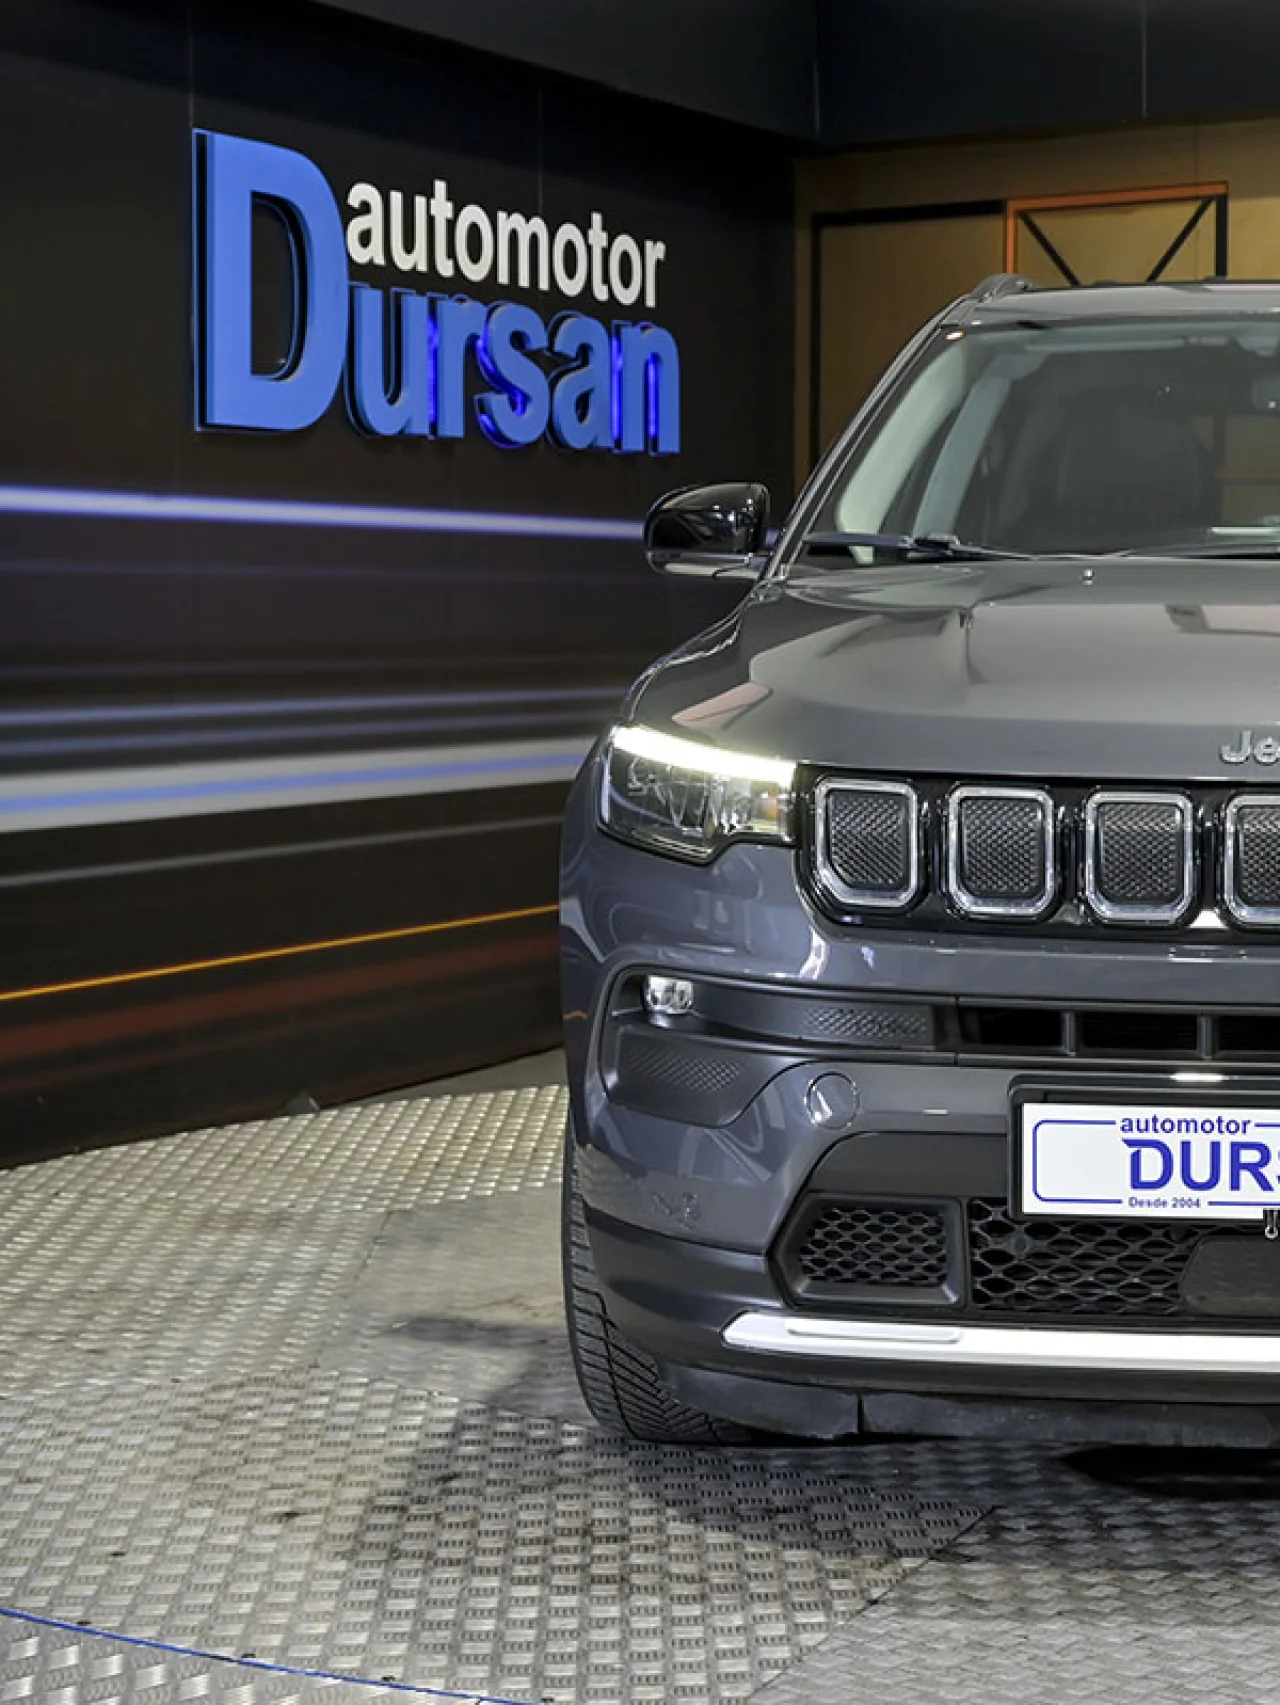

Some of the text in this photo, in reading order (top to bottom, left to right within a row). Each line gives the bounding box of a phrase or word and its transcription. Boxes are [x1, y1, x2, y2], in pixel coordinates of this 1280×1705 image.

[346, 179, 666, 308] automotor
[193, 127, 681, 455] Dursan
[1120, 1114, 1251, 1135] automotor
[1128, 1196, 1202, 1210] Desde 2004
